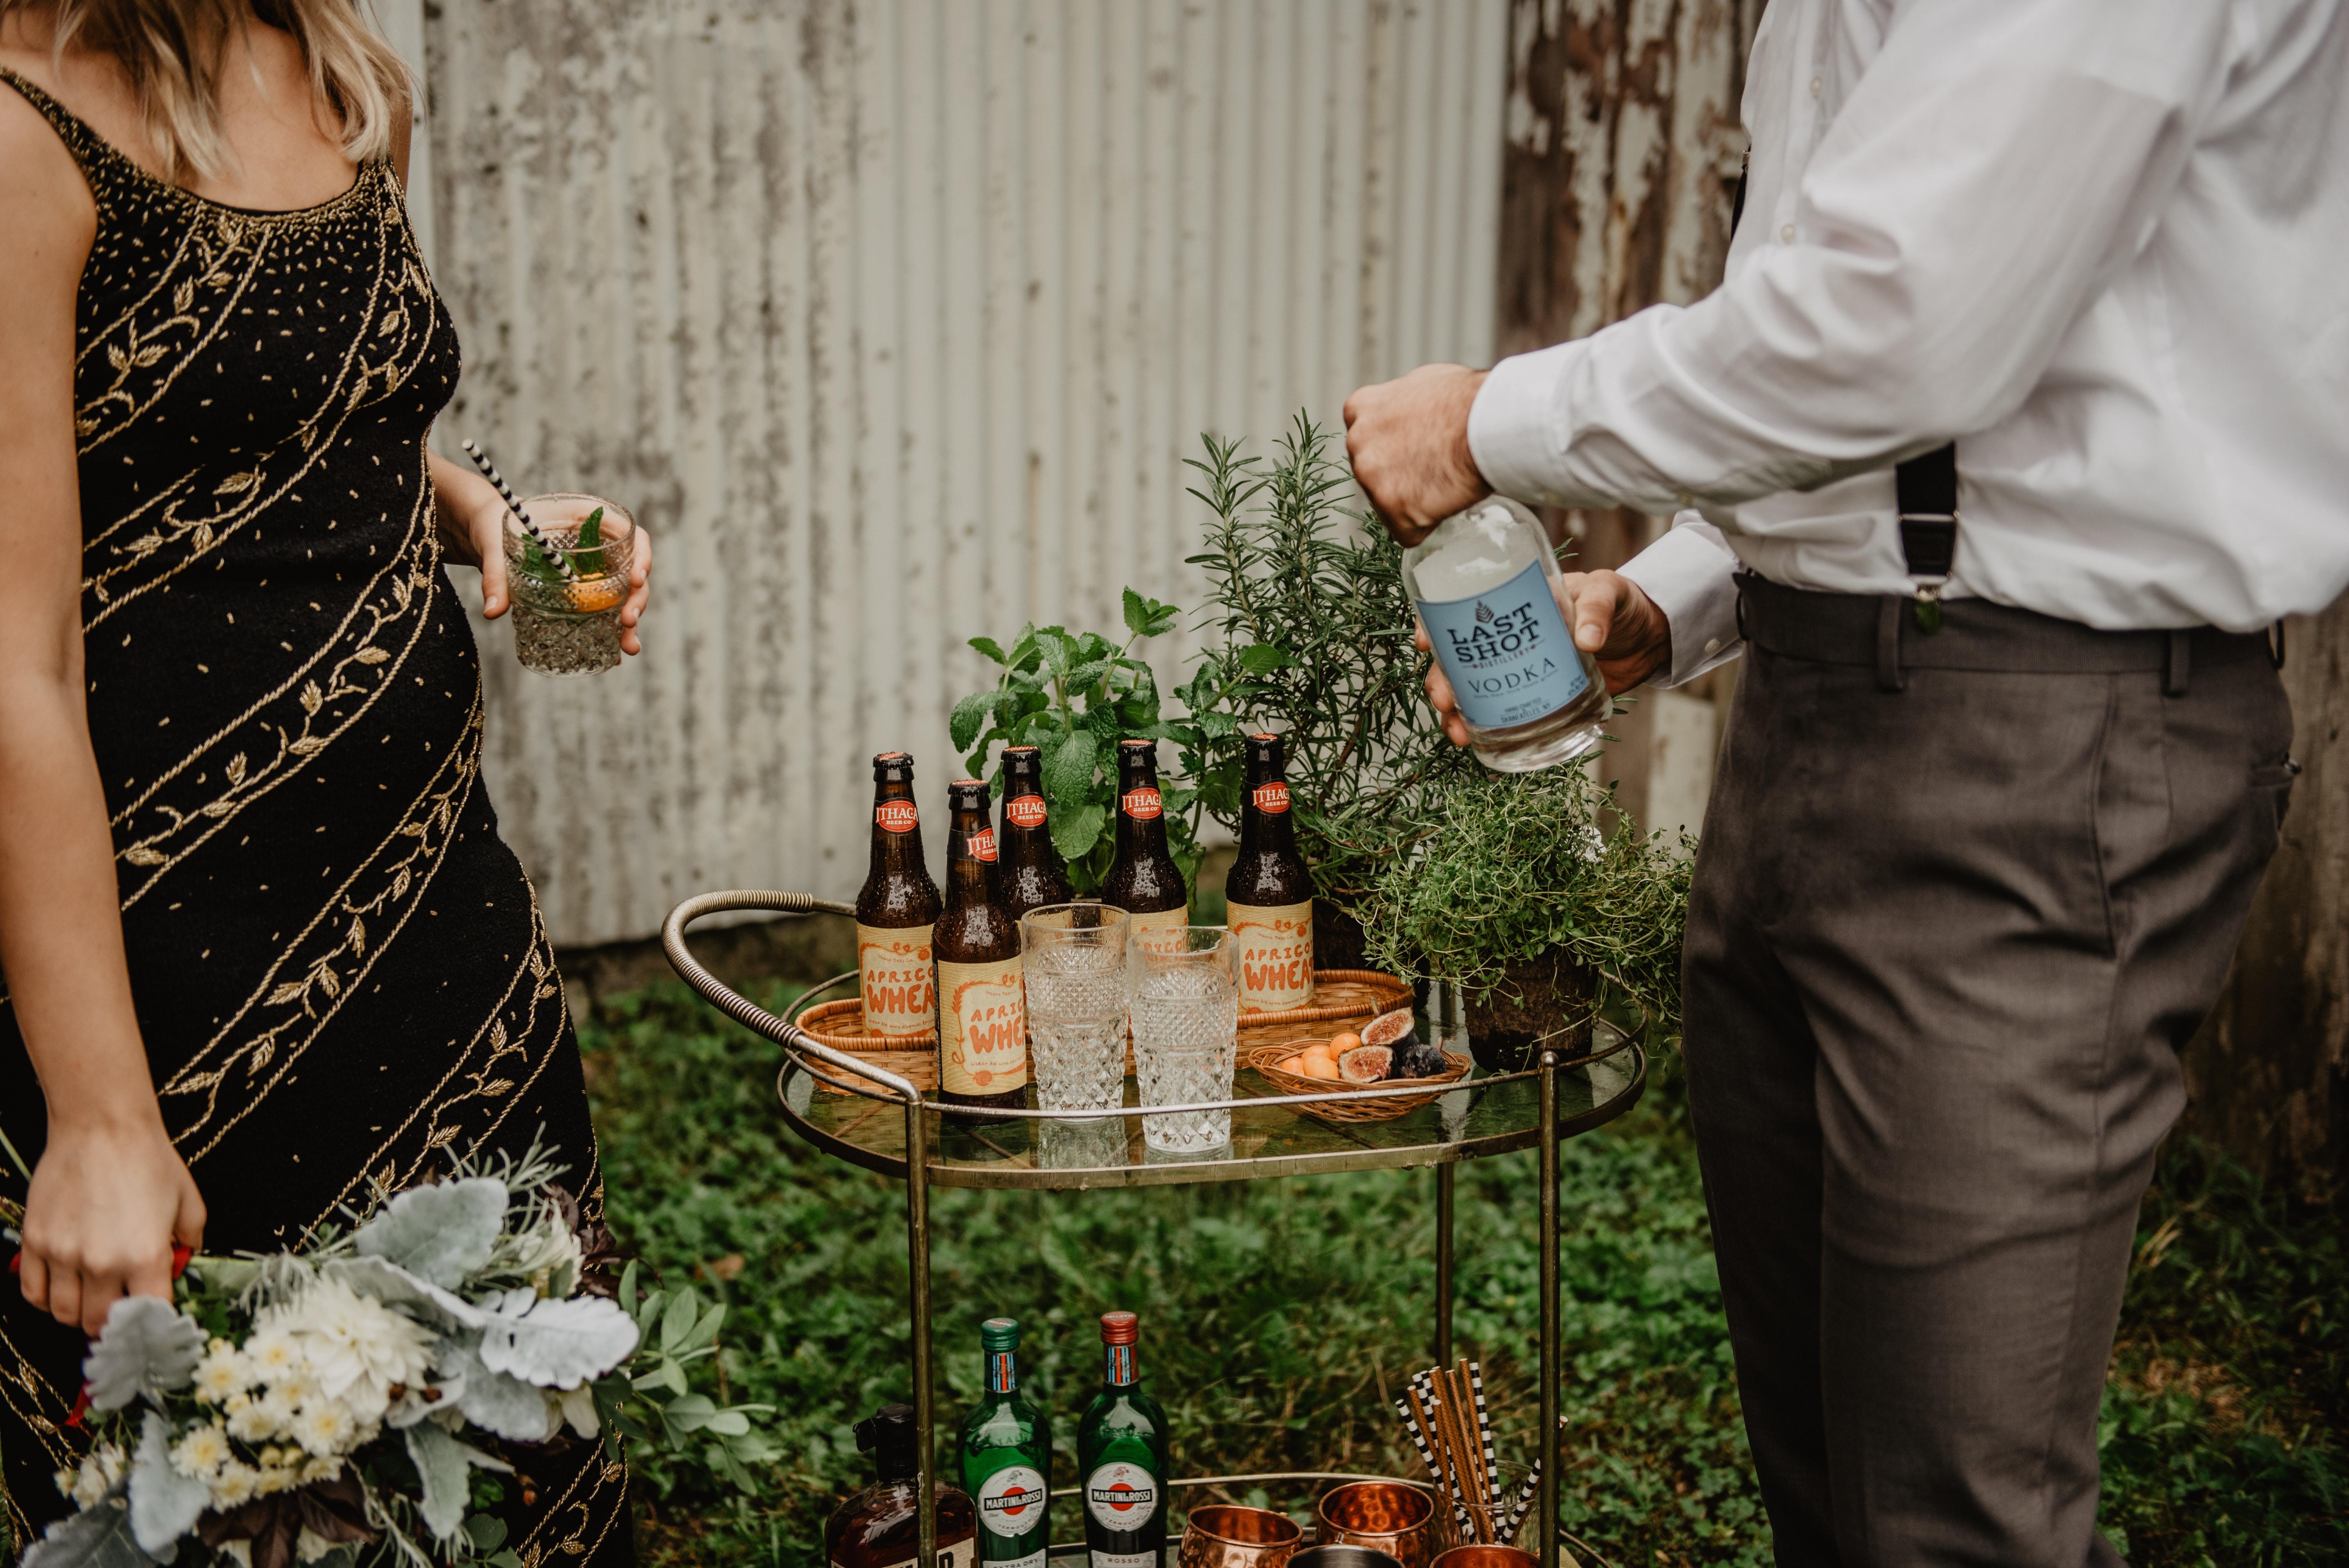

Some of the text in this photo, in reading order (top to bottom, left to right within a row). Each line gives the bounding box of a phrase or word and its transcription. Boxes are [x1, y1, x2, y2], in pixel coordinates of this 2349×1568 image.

[1447, 602, 1532, 644] LAST
[1455, 620, 1539, 663] SHOT
[1479, 648, 1529, 668] DISTILLERY
[1468, 657, 1555, 694] VODKA
[1006, 801, 1048, 819] ITHACA
[1122, 794, 1163, 812] ITHACA
[875, 807, 919, 823] ITHACA
